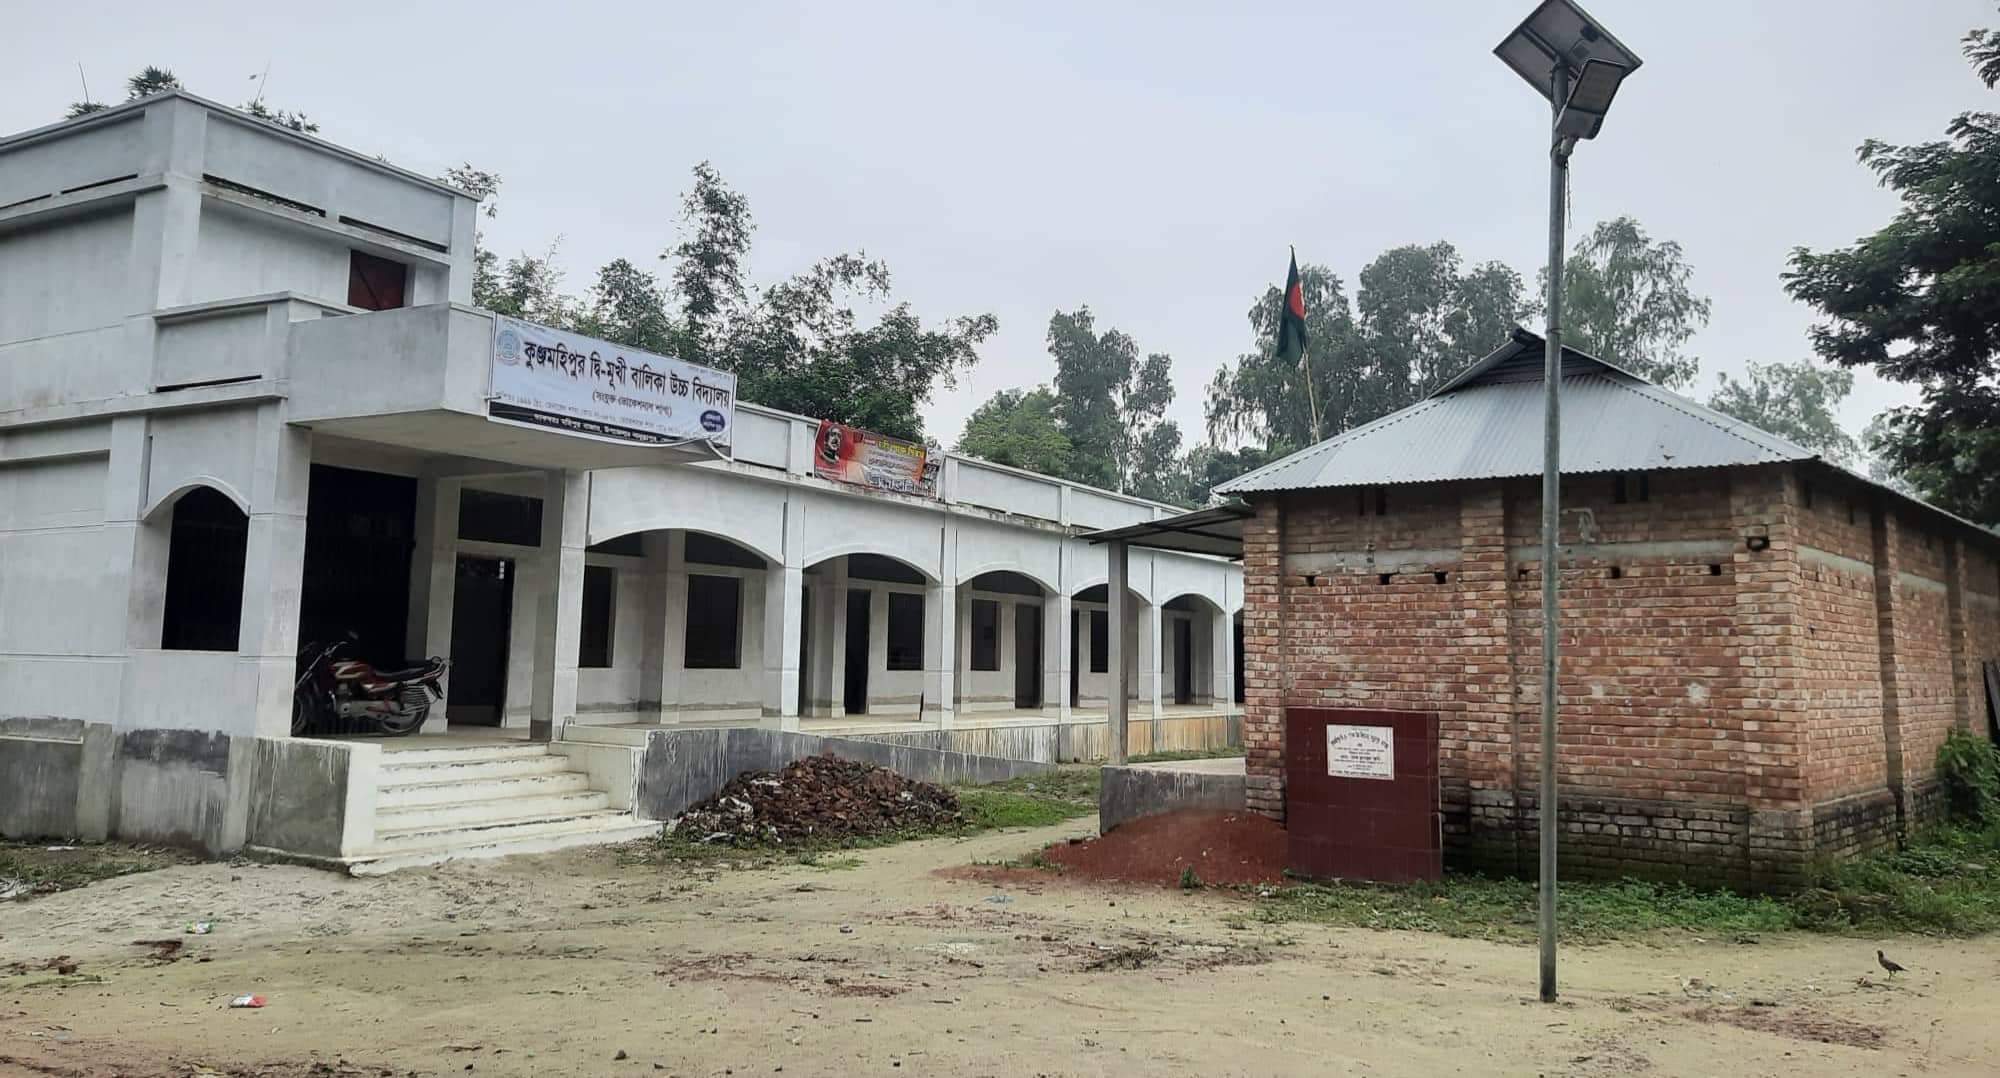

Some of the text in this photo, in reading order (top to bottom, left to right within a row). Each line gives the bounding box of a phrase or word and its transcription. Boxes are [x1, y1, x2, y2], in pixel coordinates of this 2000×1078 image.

[631, 364, 666, 396] বালিকা
[670, 370, 689, 397] উচ্চ
[693, 376, 731, 410] বিদ্যালয়
